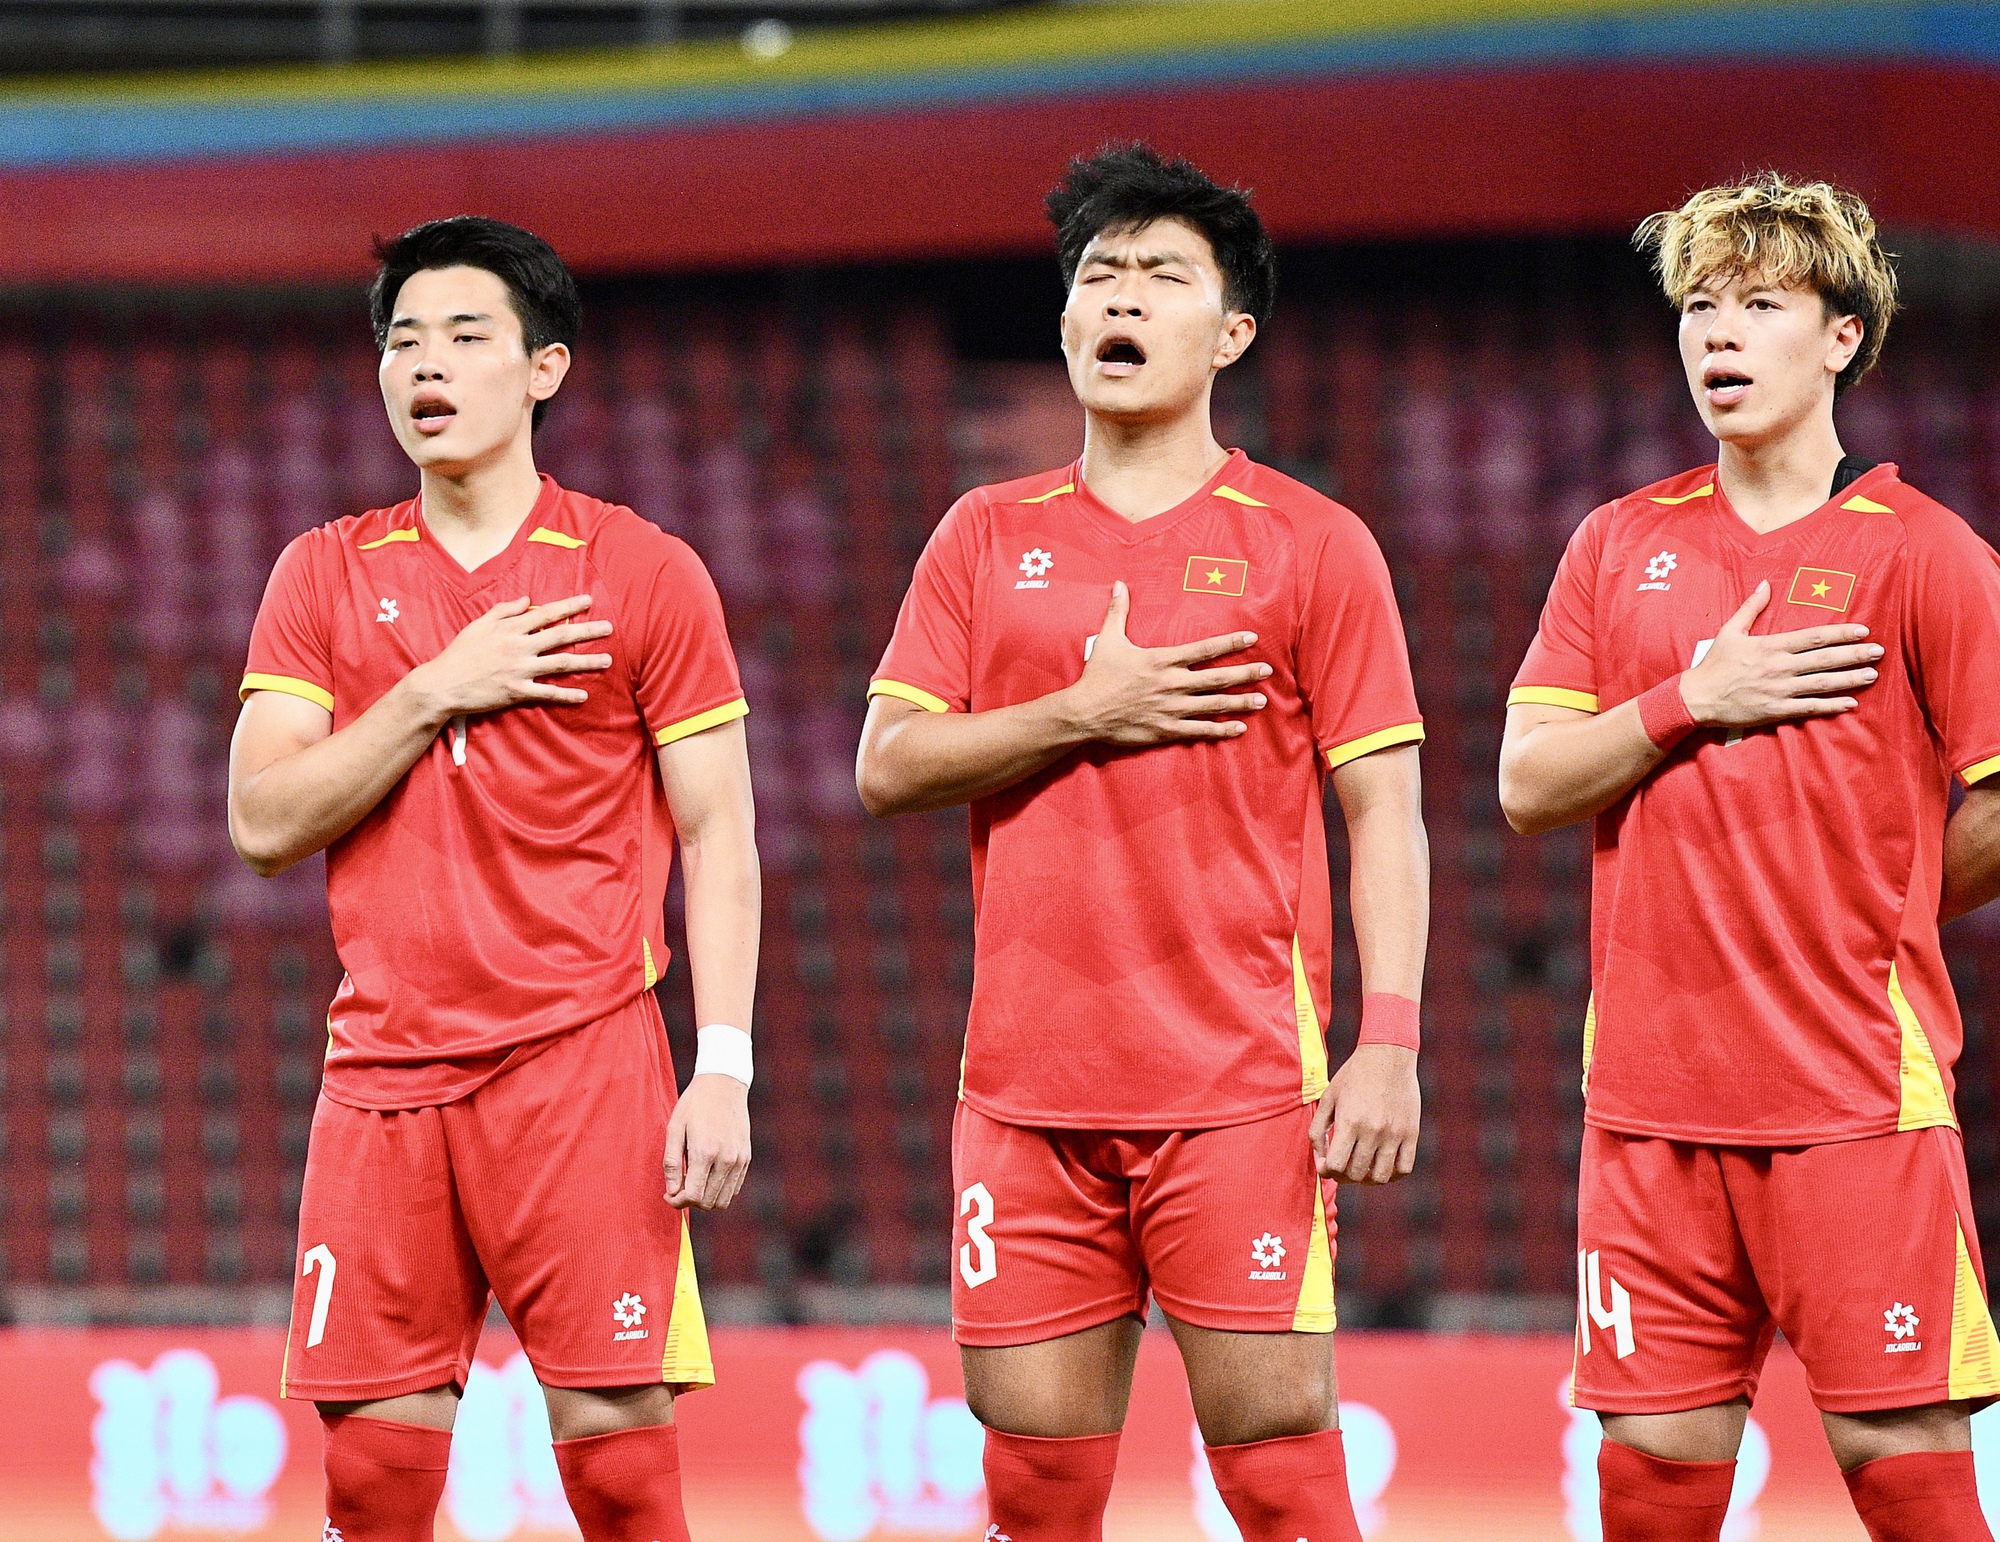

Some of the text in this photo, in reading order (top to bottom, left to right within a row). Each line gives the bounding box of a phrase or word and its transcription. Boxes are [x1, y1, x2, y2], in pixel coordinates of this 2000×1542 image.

[958, 1180, 998, 1291] 3
[1248, 1270, 1286, 1280] JOGARBOLA
[302, 1243, 337, 1349] 7
[1578, 1247, 1637, 1361] 14
[1884, 1341, 1922, 1353] JOGARBOLA
